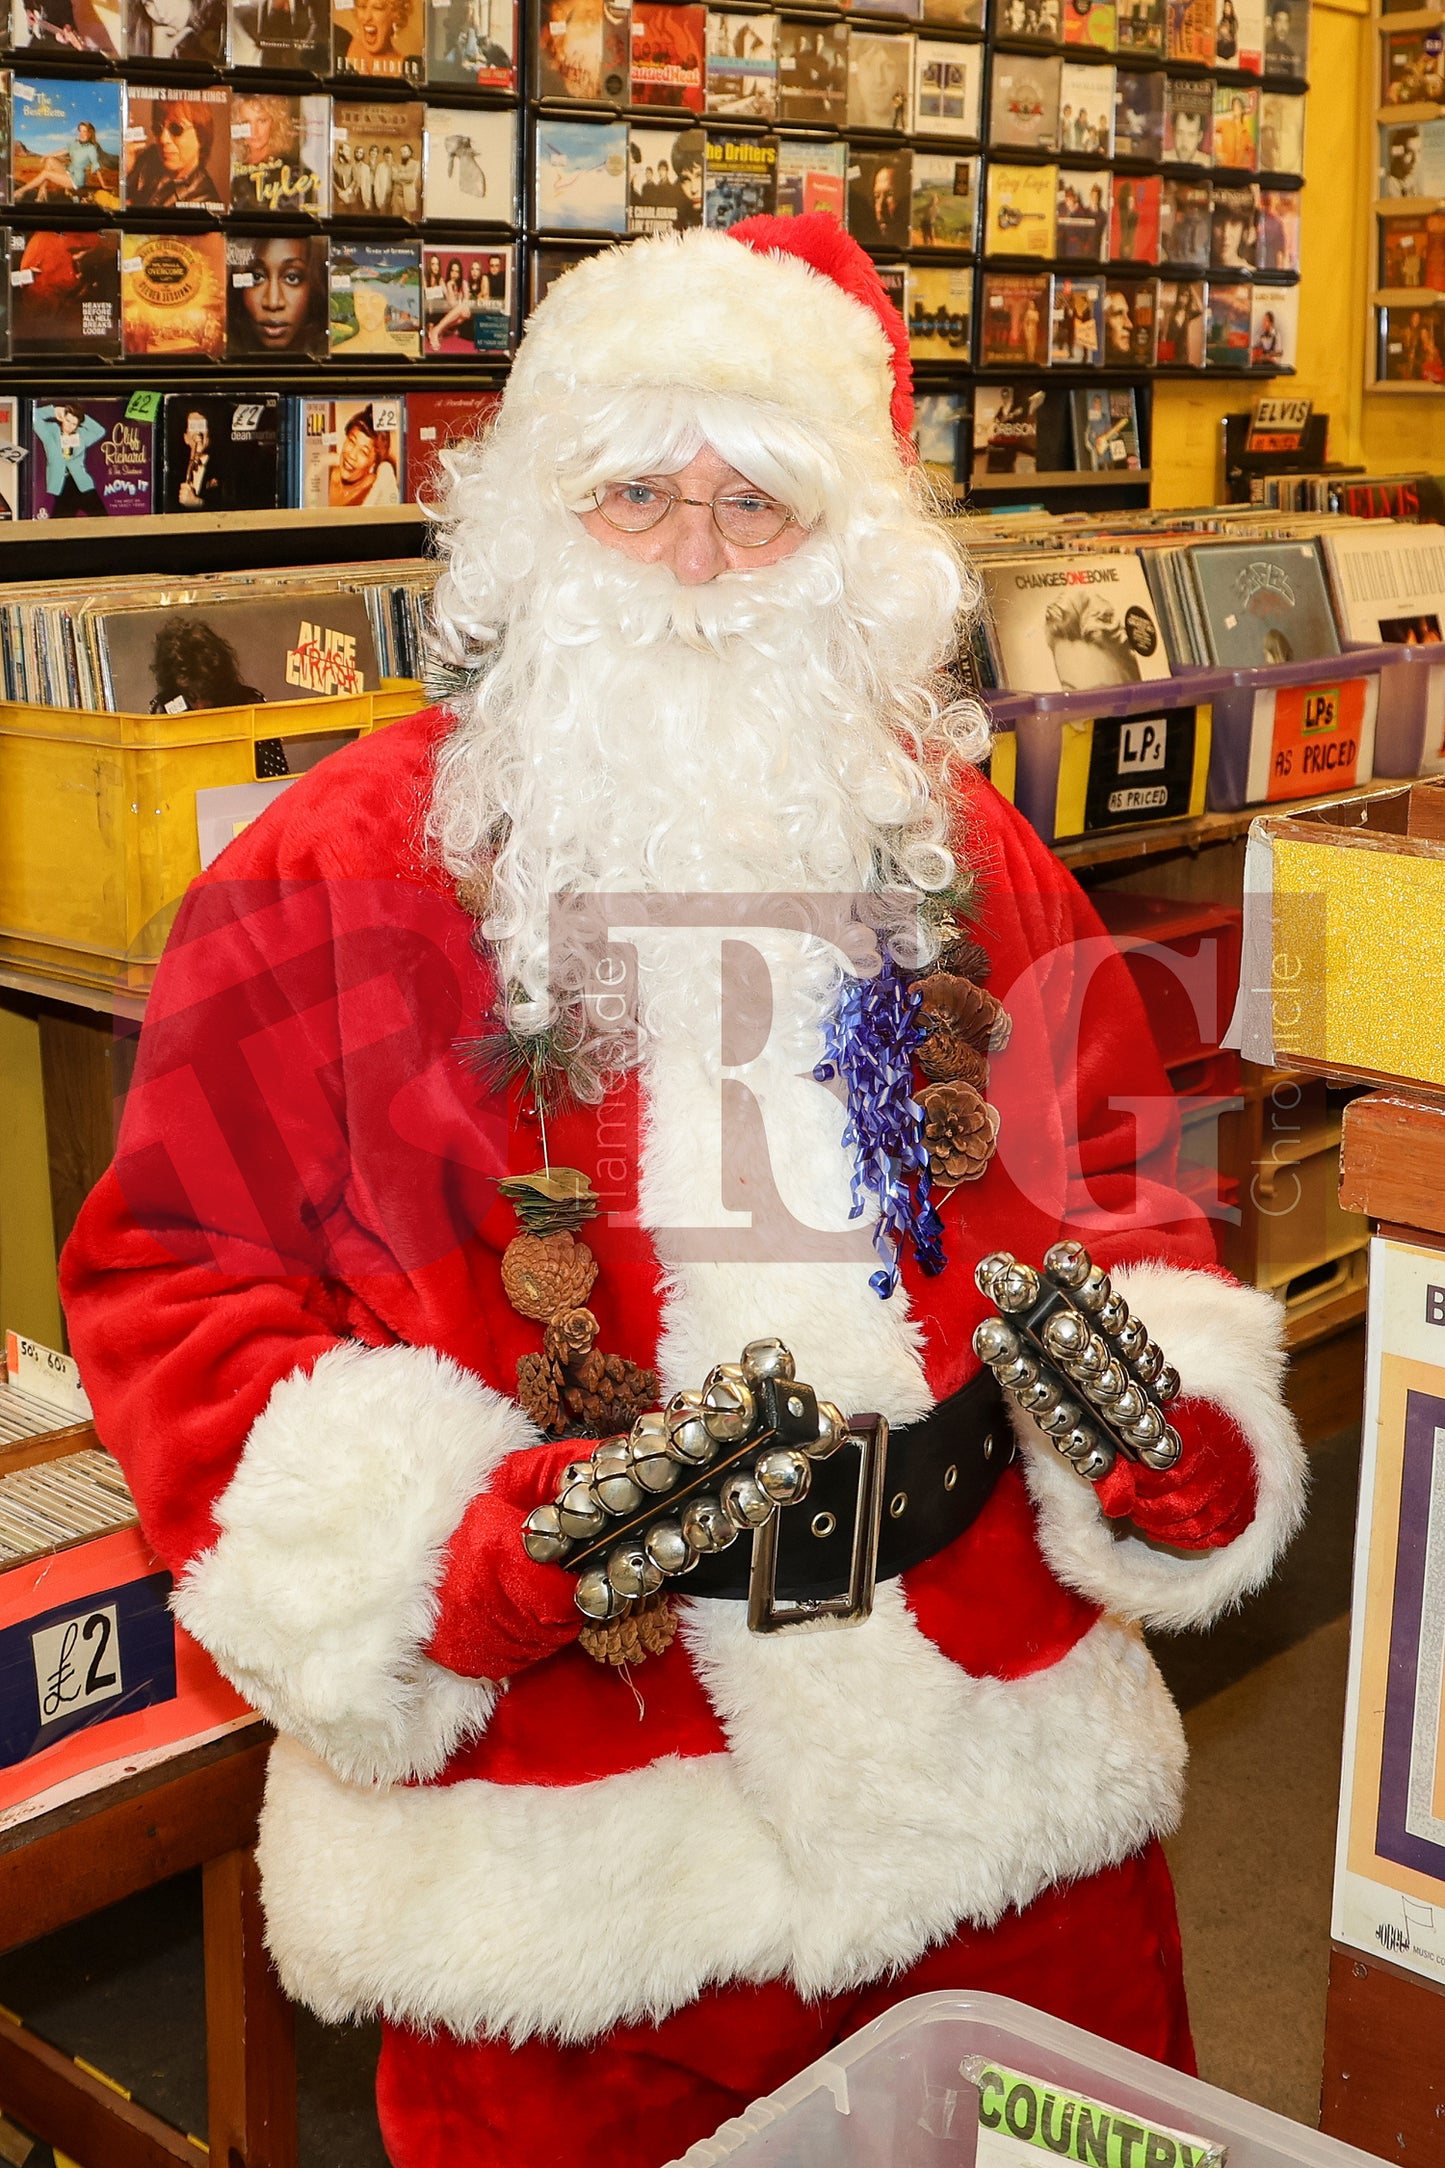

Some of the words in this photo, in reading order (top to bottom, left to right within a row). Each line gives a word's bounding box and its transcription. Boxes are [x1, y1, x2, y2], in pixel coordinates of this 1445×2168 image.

[631, 67, 667, 82] anned
[201, 90, 228, 103] KINGS
[706, 143, 722, 162] he
[725, 144, 777, 164] Drifters
[249, 165, 322, 210] Tyler
[147, 268, 184, 276] OVERCOME
[128, 394, 151, 414] £2
[1258, 401, 1308, 423] ELVIS
[233, 406, 260, 428] £2
[376, 410, 397, 428] £2
[112, 422, 140, 451] Cliff
[993, 422, 1037, 436] ORBISON
[101, 441, 147, 466] Richard
[103, 480, 137, 497] MOVE
[137, 479, 149, 492] IT
[1350, 483, 1420, 519] ELVIS
[1015, 568, 1120, 590] CHANGESONEBOWIE
[298, 621, 357, 670] ALICE
[290, 639, 359, 694] TRASH
[1306, 697, 1334, 728] LPs
[1123, 725, 1161, 763] LPs
[1275, 750, 1293, 777] AS
[1303, 738, 1357, 774] PRICED
[1110, 792, 1123, 809] AS
[1126, 790, 1167, 807] PRICED
[43, 1612, 117, 1718] £2
[1412, 1945, 1435, 1962] MUSIC
